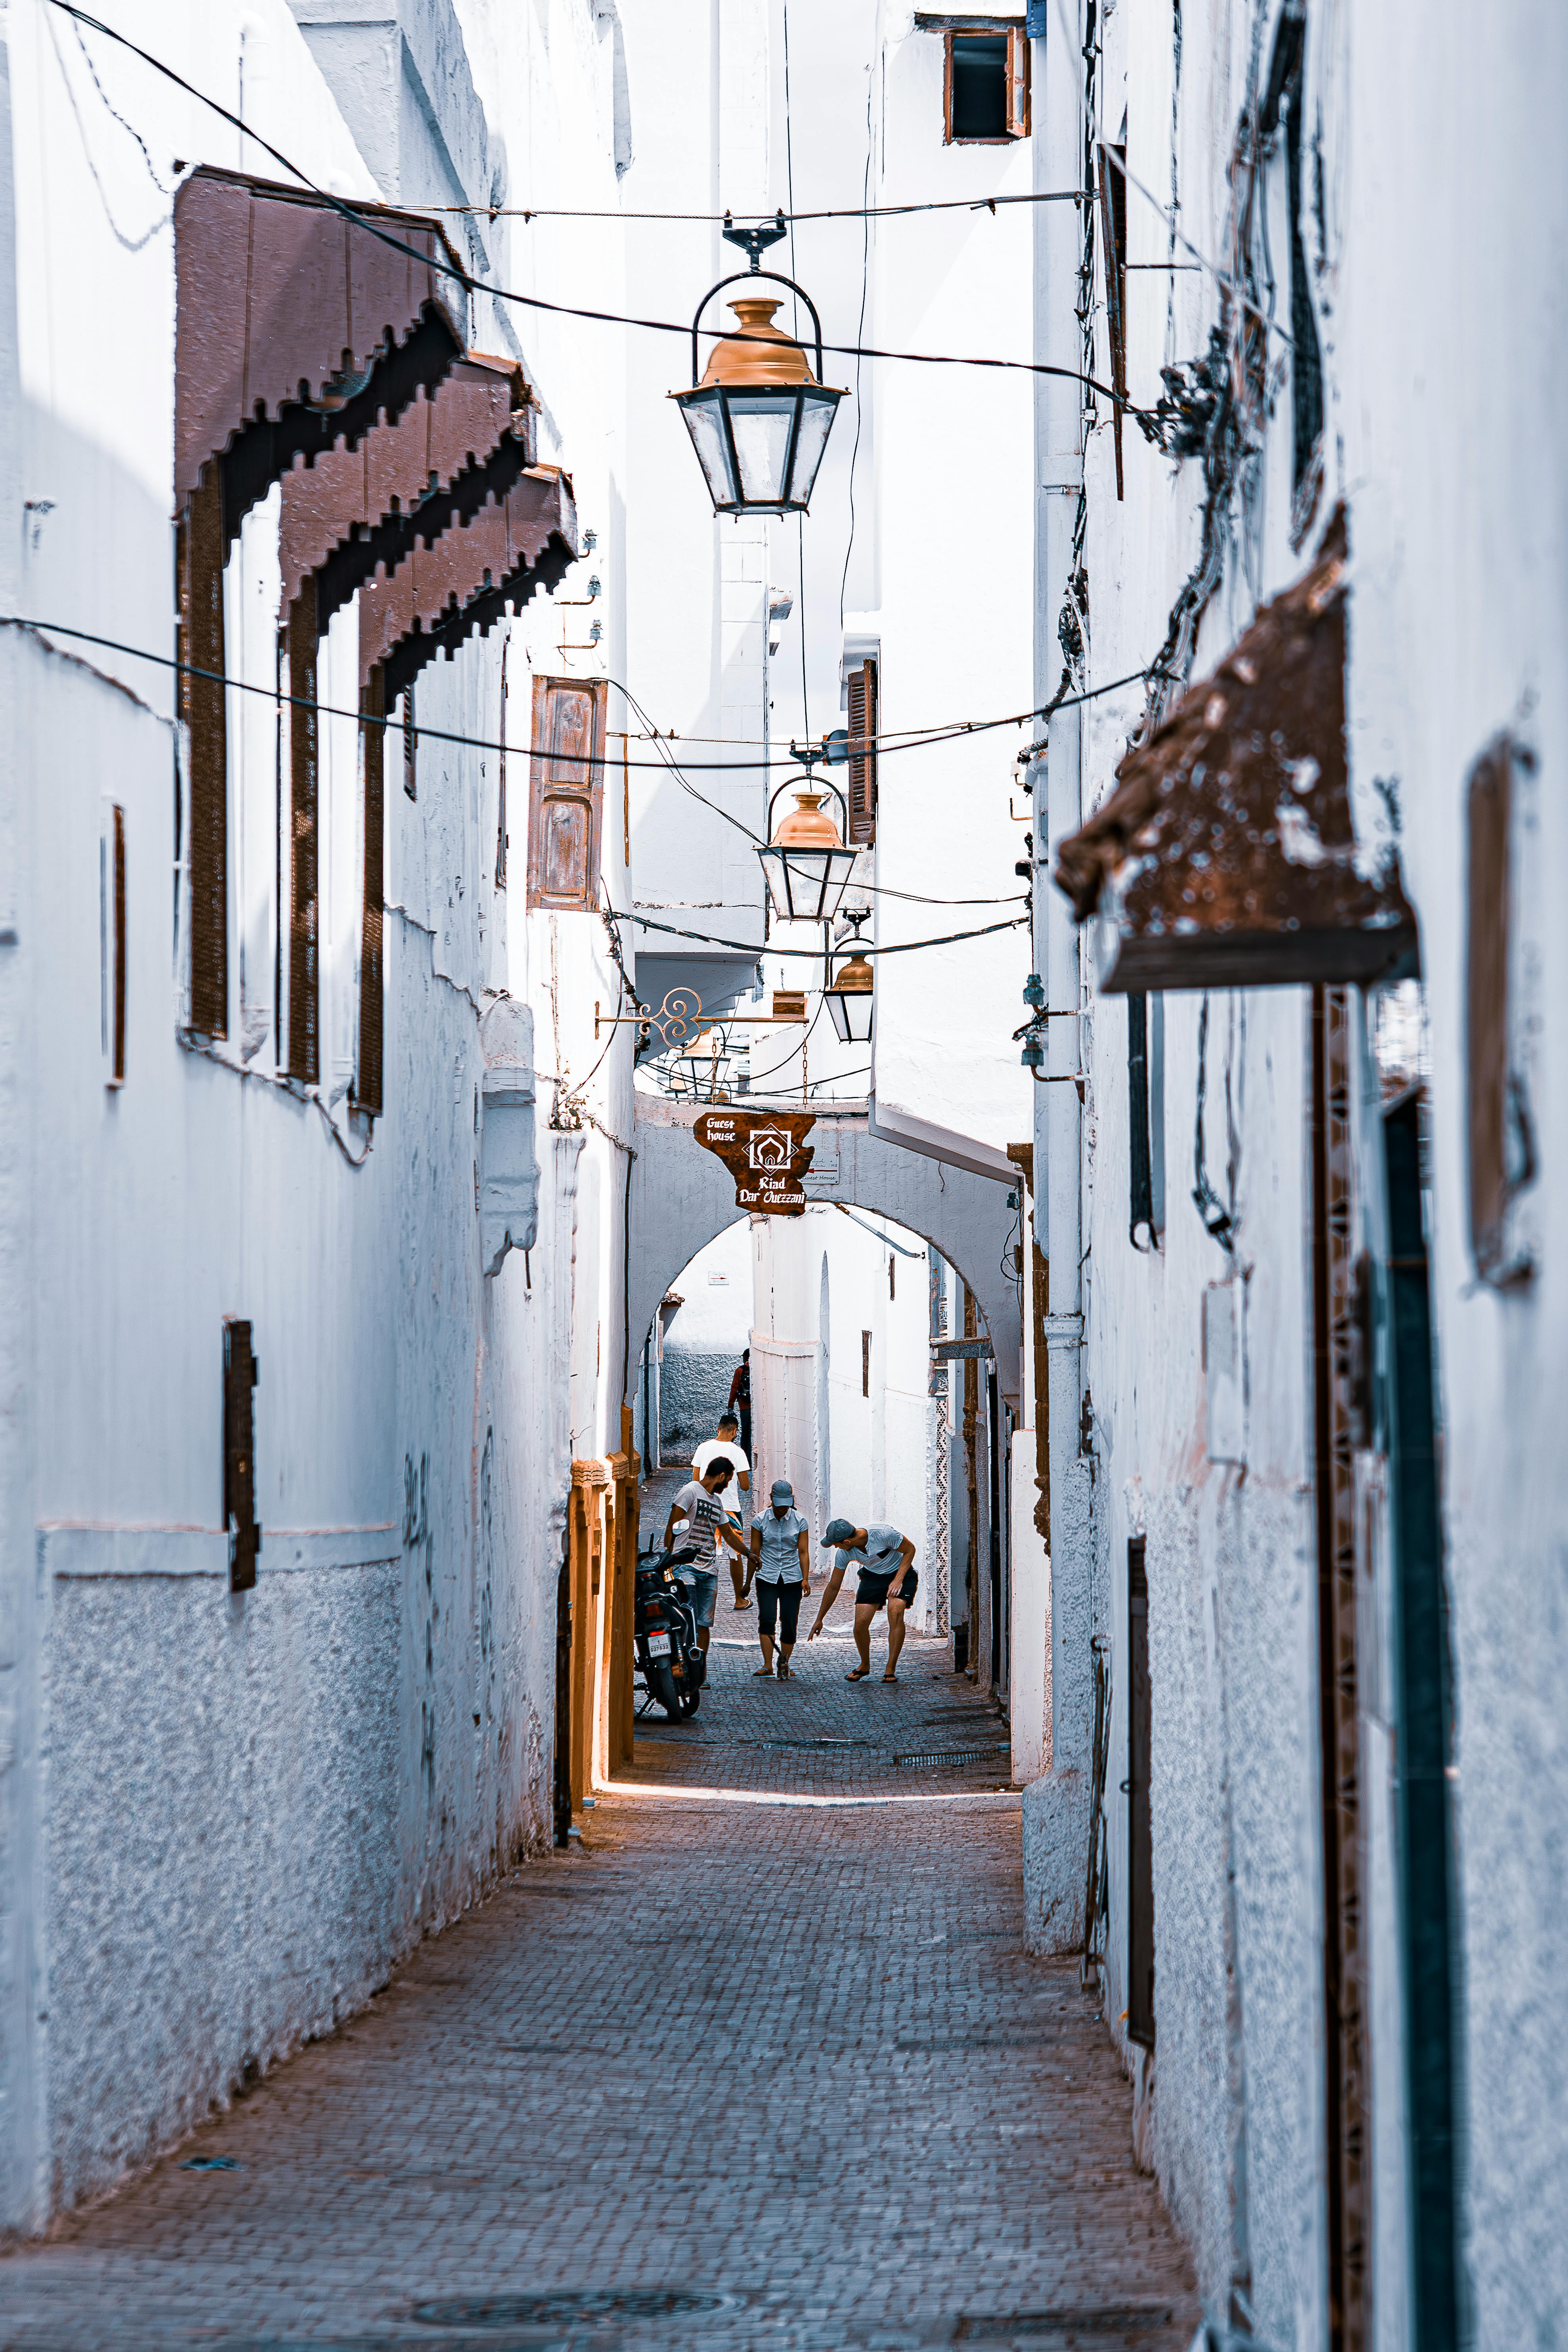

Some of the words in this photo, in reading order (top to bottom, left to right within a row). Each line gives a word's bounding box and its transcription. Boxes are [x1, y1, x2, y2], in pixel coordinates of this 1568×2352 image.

[706, 1118, 735, 1129] Guest
[707, 1129, 736, 1142] house
[758, 1177, 786, 1190] Riad
[739, 1189, 761, 1203] Dar
[764, 1190, 805, 1204] Ouezzani
